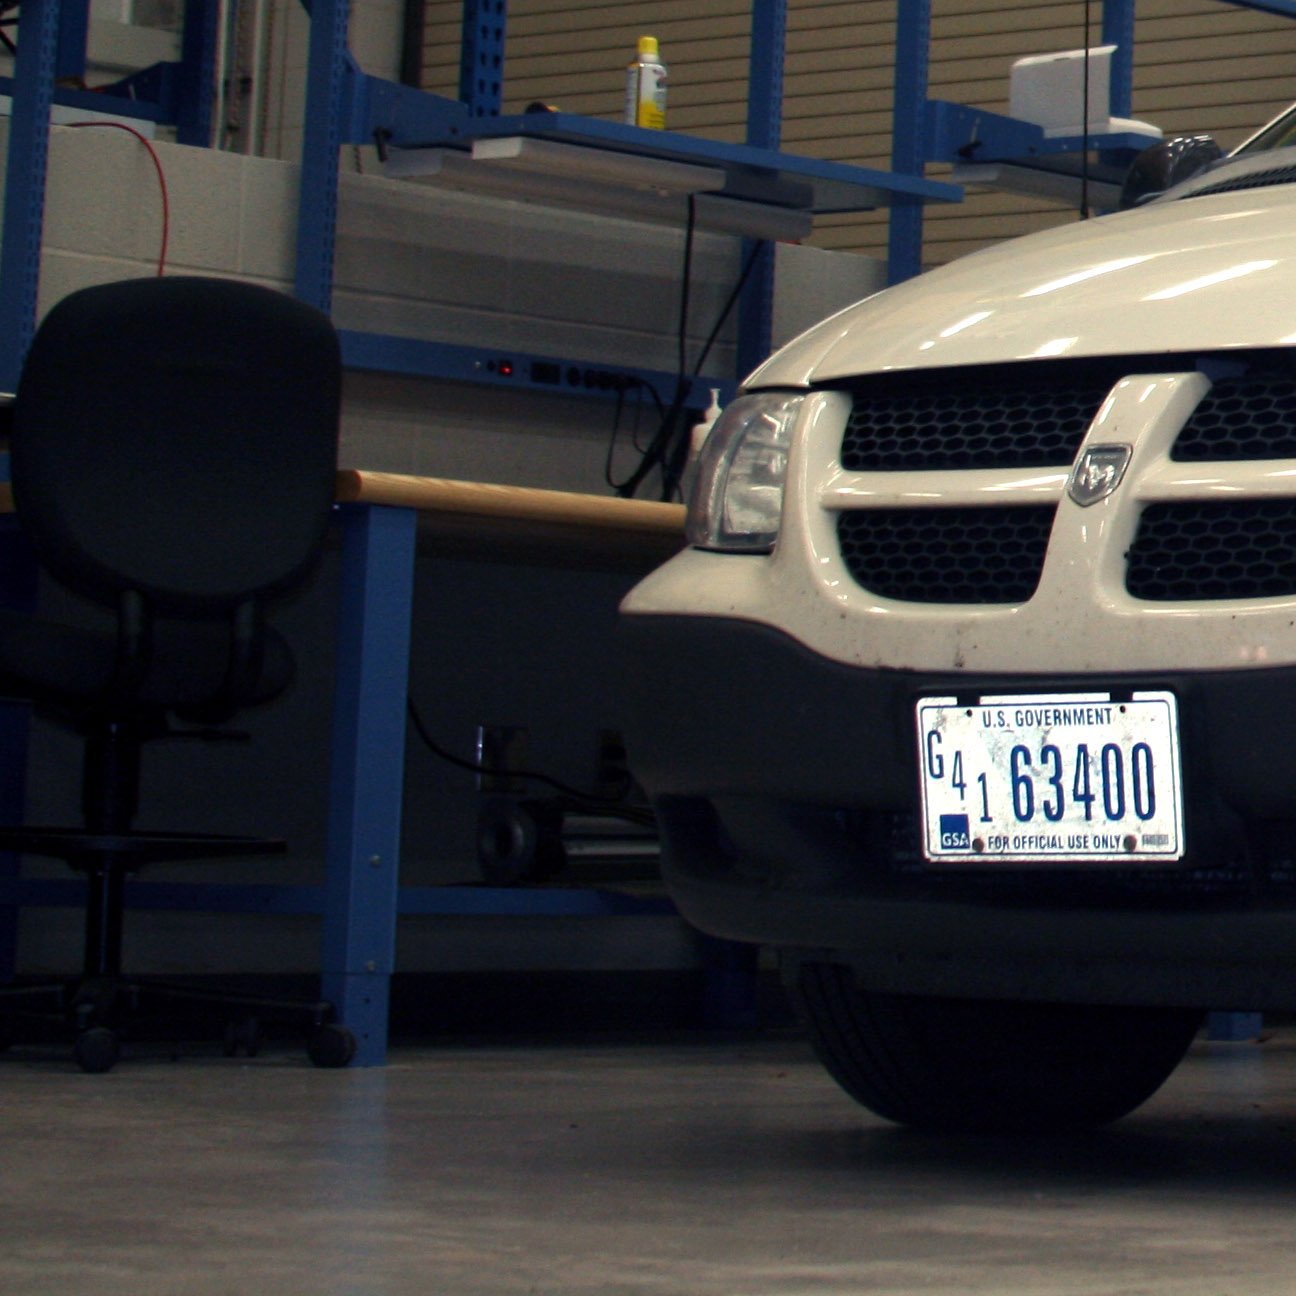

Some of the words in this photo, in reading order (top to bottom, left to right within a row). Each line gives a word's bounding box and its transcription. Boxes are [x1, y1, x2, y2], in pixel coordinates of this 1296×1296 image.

[982, 710, 1010, 728] U.S.
[1015, 707, 1113, 727] GOVERNMENT
[1010, 741, 1156, 822] 63400
[942, 832, 970, 847] GSA
[988, 835, 1010, 850] FOR
[1013, 835, 1064, 850] OFFICIAL
[1067, 835, 1089, 849] USE
[1093, 834, 1122, 849] ONLY
